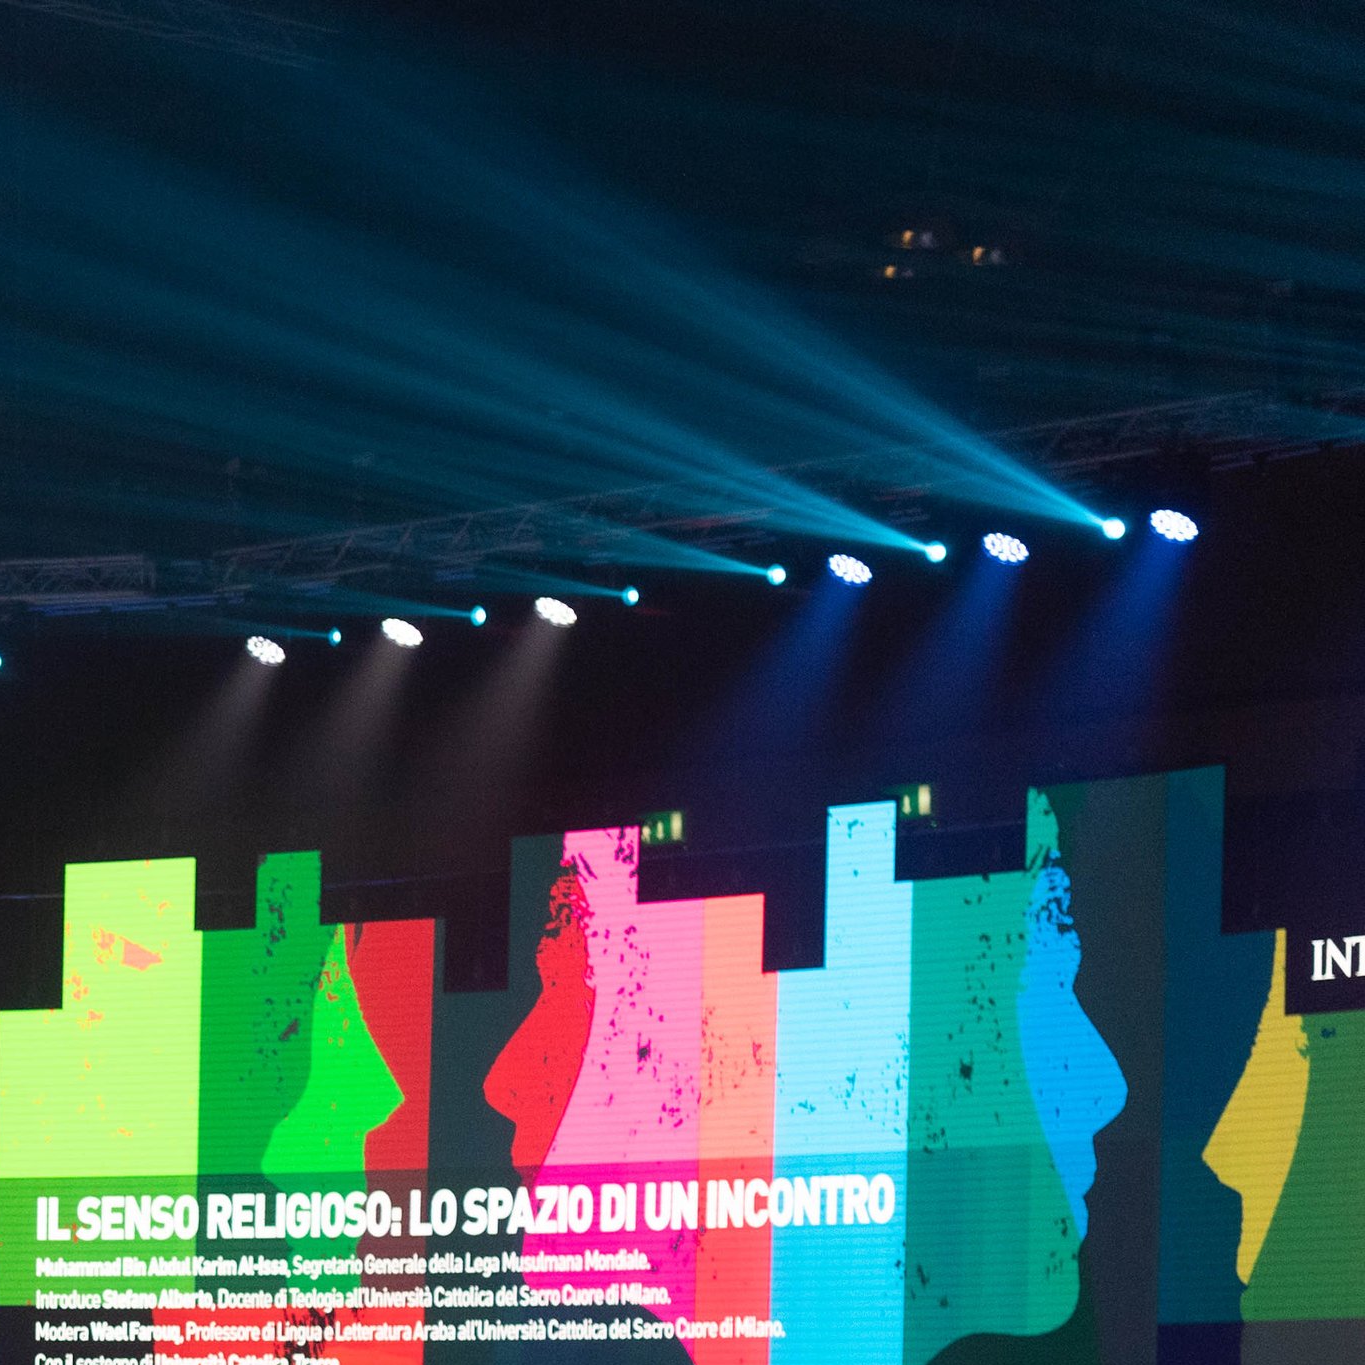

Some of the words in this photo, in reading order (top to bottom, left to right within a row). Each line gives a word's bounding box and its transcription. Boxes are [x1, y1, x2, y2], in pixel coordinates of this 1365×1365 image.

[36, 1196, 72, 1240] IL
[74, 1195, 200, 1241] SENSO
[207, 1191, 403, 1239] RELIGIOSO:
[409, 1189, 458, 1236] LO
[462, 1185, 593, 1236] SPAZIO
[599, 1183, 637, 1232] DI
[644, 1181, 699, 1231] UN
[706, 1173, 896, 1229] INCONTRO
[36, 1257, 121, 1277] Muhammad
[122, 1256, 146, 1277] Bin
[148, 1256, 191, 1277] Abdul
[192, 1255, 237, 1277] Karim
[292, 1254, 362, 1280] Segretario
[364, 1253, 427, 1275] Generale
[428, 1252, 463, 1274] della
[465, 1252, 500, 1278] Lega
[502, 1251, 583, 1273] Musulmana
[584, 1248, 651, 1271] Mondiale.
[36, 1289, 101, 1310] Introduce
[102, 1288, 157, 1310] Stefano
[158, 1288, 216, 1312] Alberto,
[217, 1288, 272, 1309] Docente
[274, 1288, 287, 1309] di
[289, 1287, 344, 1312] Teologia
[345, 1285, 432, 1309] all'Università
[434, 1285, 493, 1308] Cattolica
[495, 1285, 518, 1307] del
[519, 1284, 561, 1307] Sacro
[562, 1284, 604, 1306] Cuore
[605, 1283, 619, 1306] di
[620, 1282, 671, 1306] Milano.
[35, 1321, 89, 1342] Modera
[90, 1321, 127, 1342] Wael
[186, 1321, 260, 1342] Professore
[261, 1321, 275, 1342] di
[276, 1321, 322, 1345] Lingua
[324, 1325, 334, 1342] e
[336, 1321, 412, 1342] Letteratura
[413, 1320, 456, 1341] Araba
[457, 1318, 546, 1341] all'Università
[547, 1318, 607, 1341] Cattolica
[608, 1318, 631, 1340] del
[632, 1317, 674, 1340] Sacro
[675, 1316, 718, 1339] Cuore
[718, 1316, 734, 1339] di
[734, 1315, 786, 1340] Milano.
